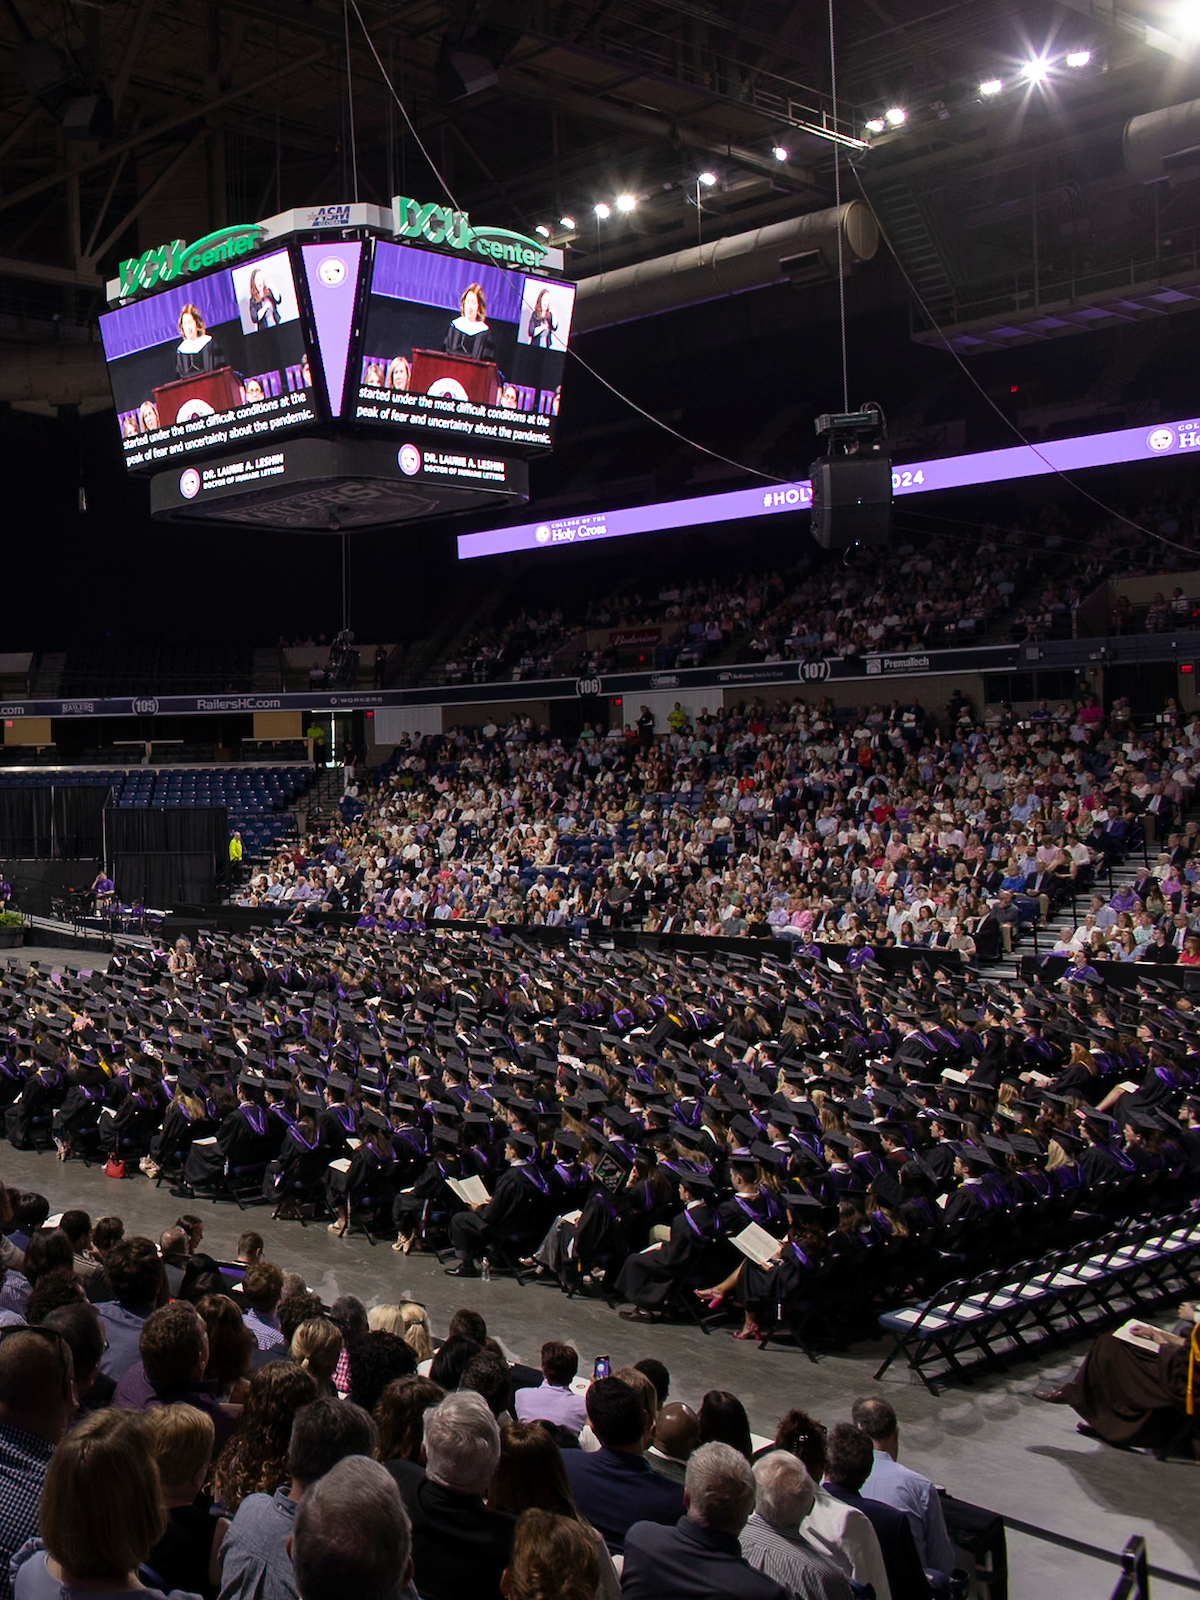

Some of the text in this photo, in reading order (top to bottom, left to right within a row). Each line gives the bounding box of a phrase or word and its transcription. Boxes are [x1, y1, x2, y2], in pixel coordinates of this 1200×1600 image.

[399, 196, 469, 249] DCU
[188, 231, 259, 272] center
[476, 237, 545, 267] center
[119, 239, 185, 298] DCU
[358, 387, 550, 427] started under the most difficult conditions at the
[123, 392, 307, 450] started under the most difficult conditions at the
[356, 405, 551, 445] peak of fear and uncertainty about the pandemic.
[125, 409, 314, 468] peak of fear and uncertainty about the pandemic.
[202, 453, 284, 480] DR. LAURIE A. LESHIN
[423, 452, 505, 472] DR. LAURIE A. LESHIN
[423, 464, 449, 475] DOCTOR
[449, 467, 457, 476] OF
[203, 478, 226, 489] DOCTOR
[226, 476, 235, 485] OF
[551, 519, 580, 529] COLLEGE
[552, 525, 607, 541] Holy Cross
[803, 662, 826, 679] 107
[884, 656, 930, 668] PremaTech
[579, 681, 599, 694] 106
[135, 699, 157, 713] 105
[197, 698, 281, 710] RailersHC.com
